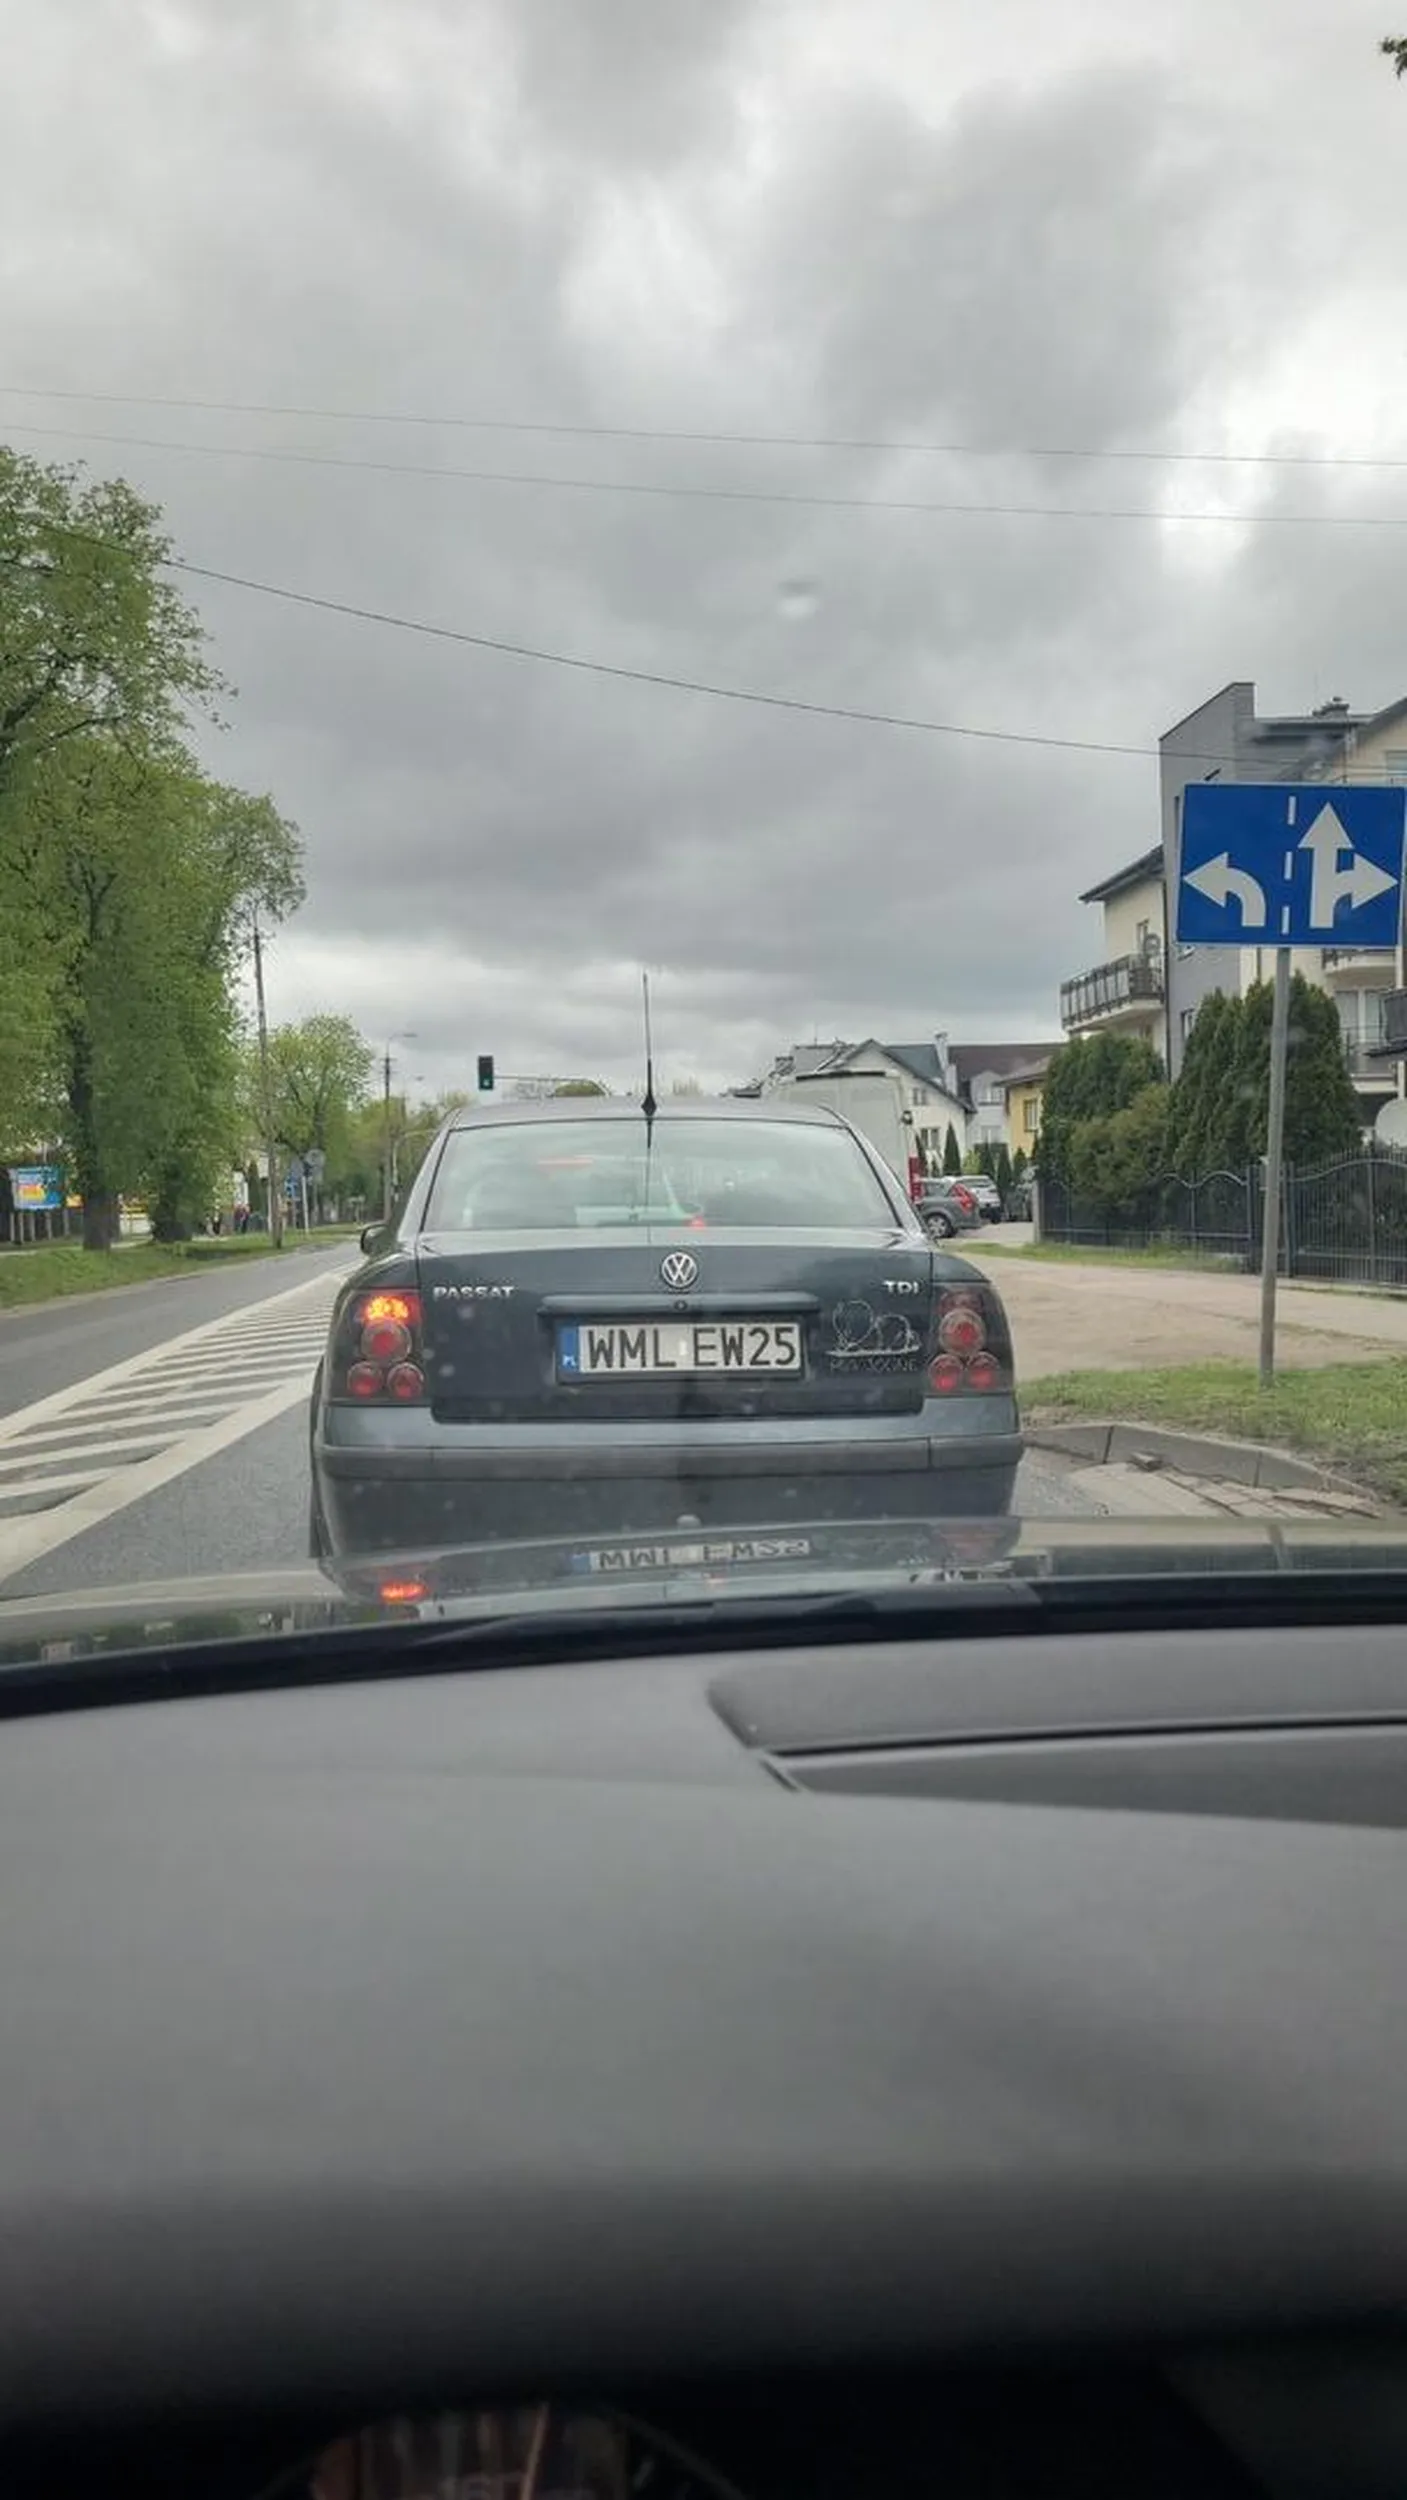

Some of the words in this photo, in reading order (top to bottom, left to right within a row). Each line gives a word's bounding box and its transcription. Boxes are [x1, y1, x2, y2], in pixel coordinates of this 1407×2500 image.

[662, 1252, 697, 1288] VW
[433, 1286, 515, 1301] PASSAT
[882, 1280, 918, 1294] TDI
[588, 1328, 677, 1368] WML
[693, 1327, 796, 1367] EW25
